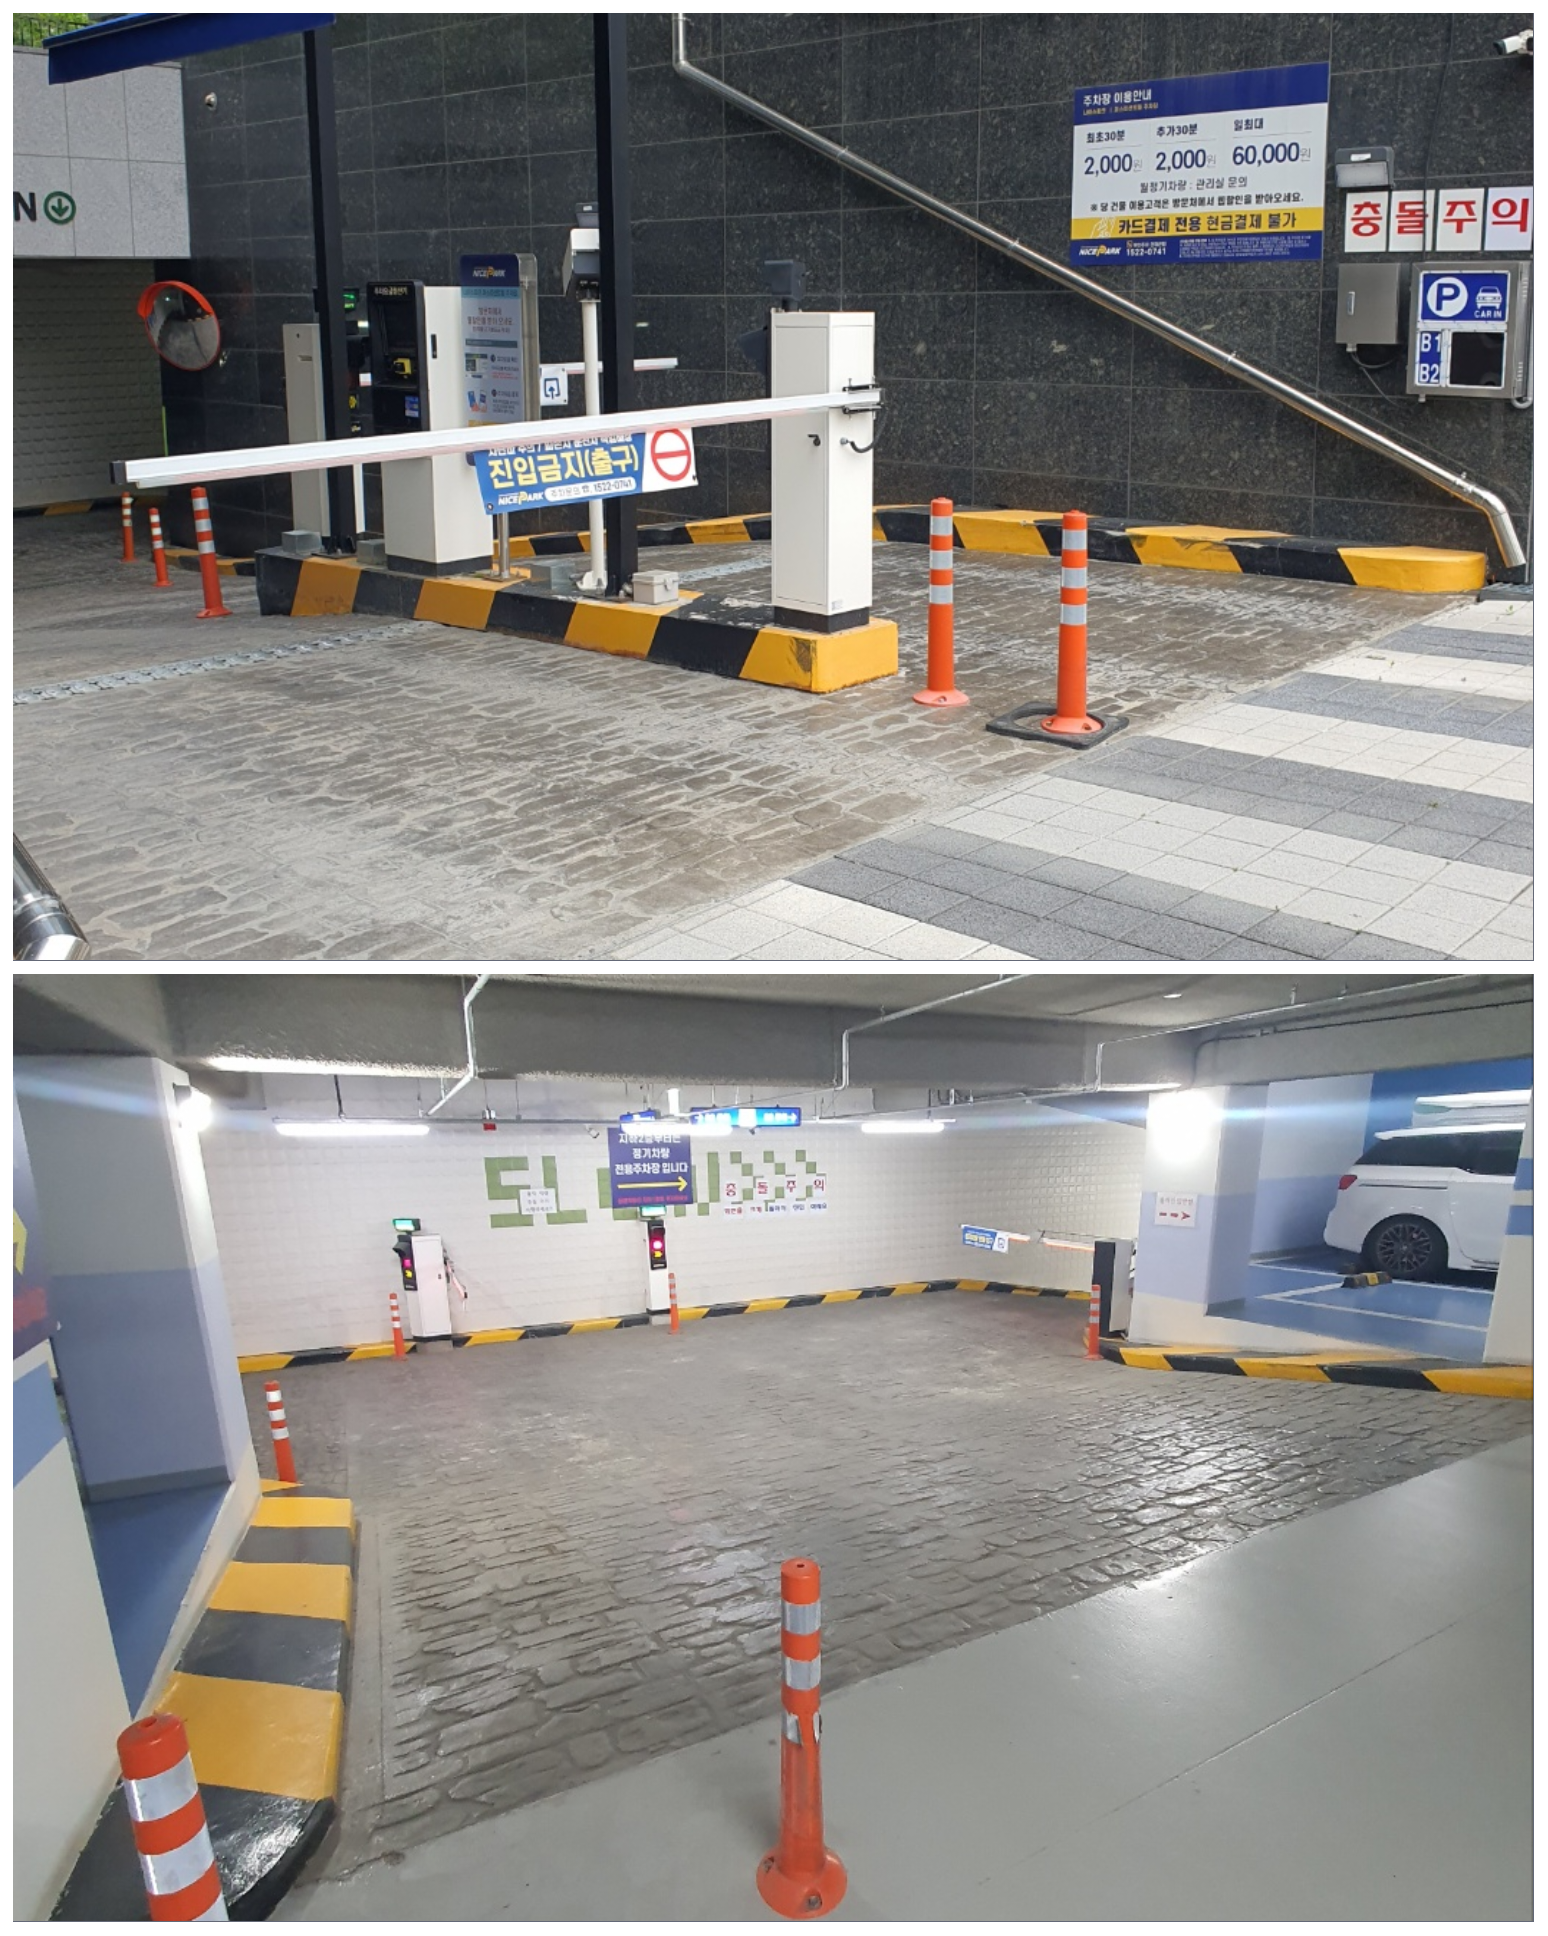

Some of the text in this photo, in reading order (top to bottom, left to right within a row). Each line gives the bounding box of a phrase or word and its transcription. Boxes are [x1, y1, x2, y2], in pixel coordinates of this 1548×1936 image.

[1083, 88, 1152, 107] 주차장 이용안내
[1156, 123, 1198, 137] 추가30분
[1234, 118, 1264, 131] 일최대
[1086, 129, 1125, 143] 최초30분
[1155, 148, 1216, 173] 2,000원
[1232, 142, 1311, 167] 60,000원
[1084, 153, 1142, 177] 2,000원
[1140, 179, 1186, 193] 월정기차량
[1196, 177, 1224, 191] 관리실
[1228, 176, 1248, 188] 문의
[1111, 201, 1126, 212] 건물
[1118, 212, 1297, 234] 카드결제 전용 현금결제 불가
[1350, 198, 1530, 237] 충돌주의
[1126, 247, 1166, 256] 1522-0741
[1435, 283, 1461, 311] P
[1474, 310, 1502, 318] CAR IN
[1421, 333, 1442, 353] B1
[1419, 363, 1440, 383] B2
[488, 444, 639, 489] 진입금지(출구)
[498, 491, 545, 506] NICEPARK
[632, 1147, 670, 1159] 정기차량
[615, 1161, 689, 1176] 전용주차장 입니다
